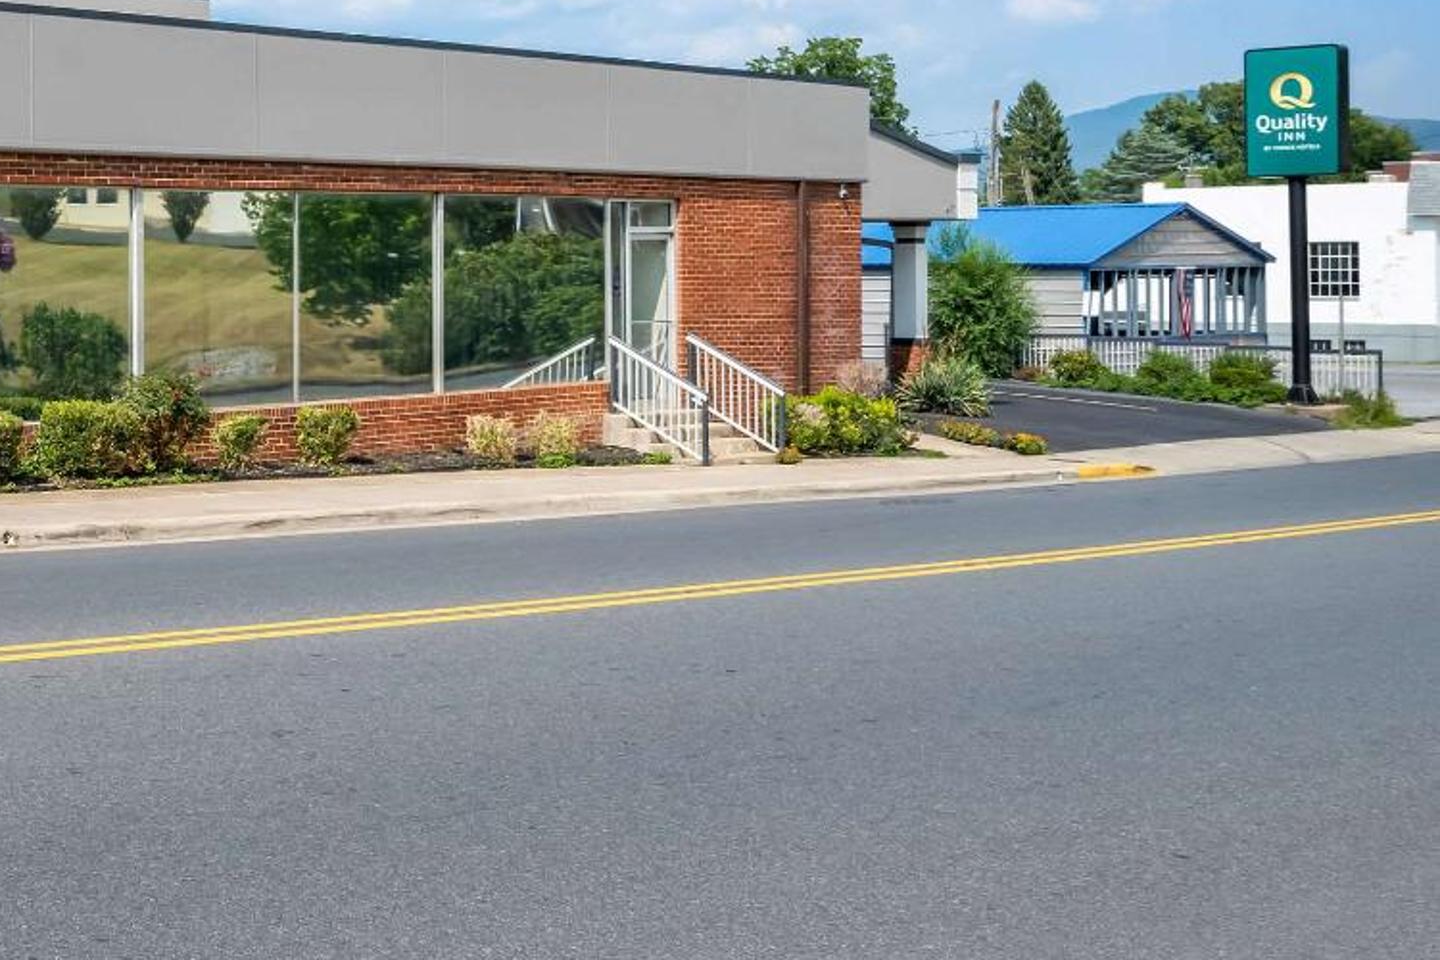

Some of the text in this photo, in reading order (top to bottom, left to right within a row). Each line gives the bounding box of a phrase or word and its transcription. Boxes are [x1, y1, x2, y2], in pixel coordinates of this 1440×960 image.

[1270, 71, 1317, 110] Q
[1255, 112, 1328, 134] Quality
[1277, 131, 1307, 142] INN
